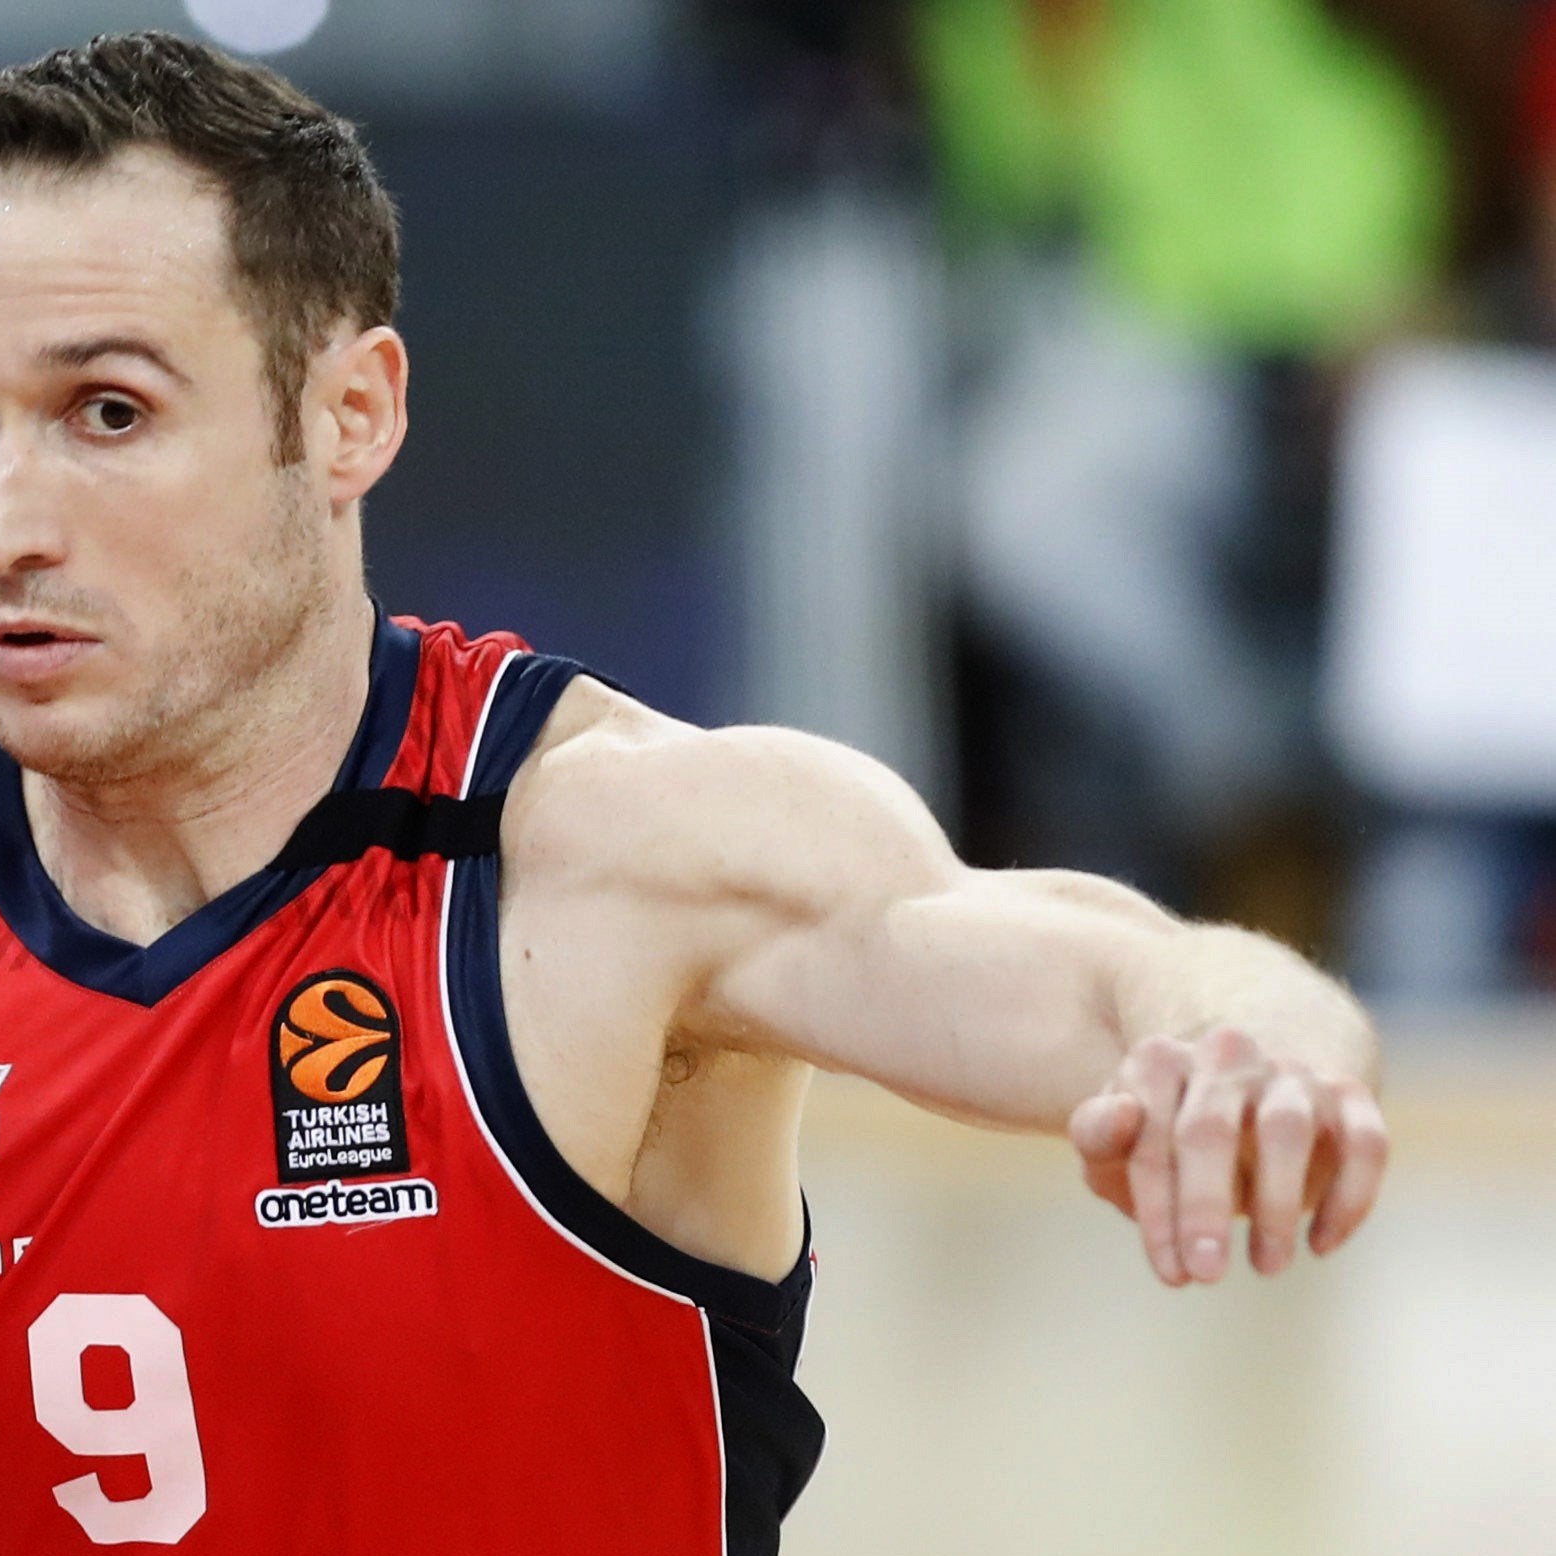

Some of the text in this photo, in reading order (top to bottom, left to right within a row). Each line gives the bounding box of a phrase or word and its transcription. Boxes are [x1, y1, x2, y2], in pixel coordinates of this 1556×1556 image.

[283, 1102, 389, 1129] TURKISH
[287, 1123, 391, 1151] AIRLINES
[288, 1147, 393, 1169] EuroLeague
[27, 1293, 207, 1545] 9
